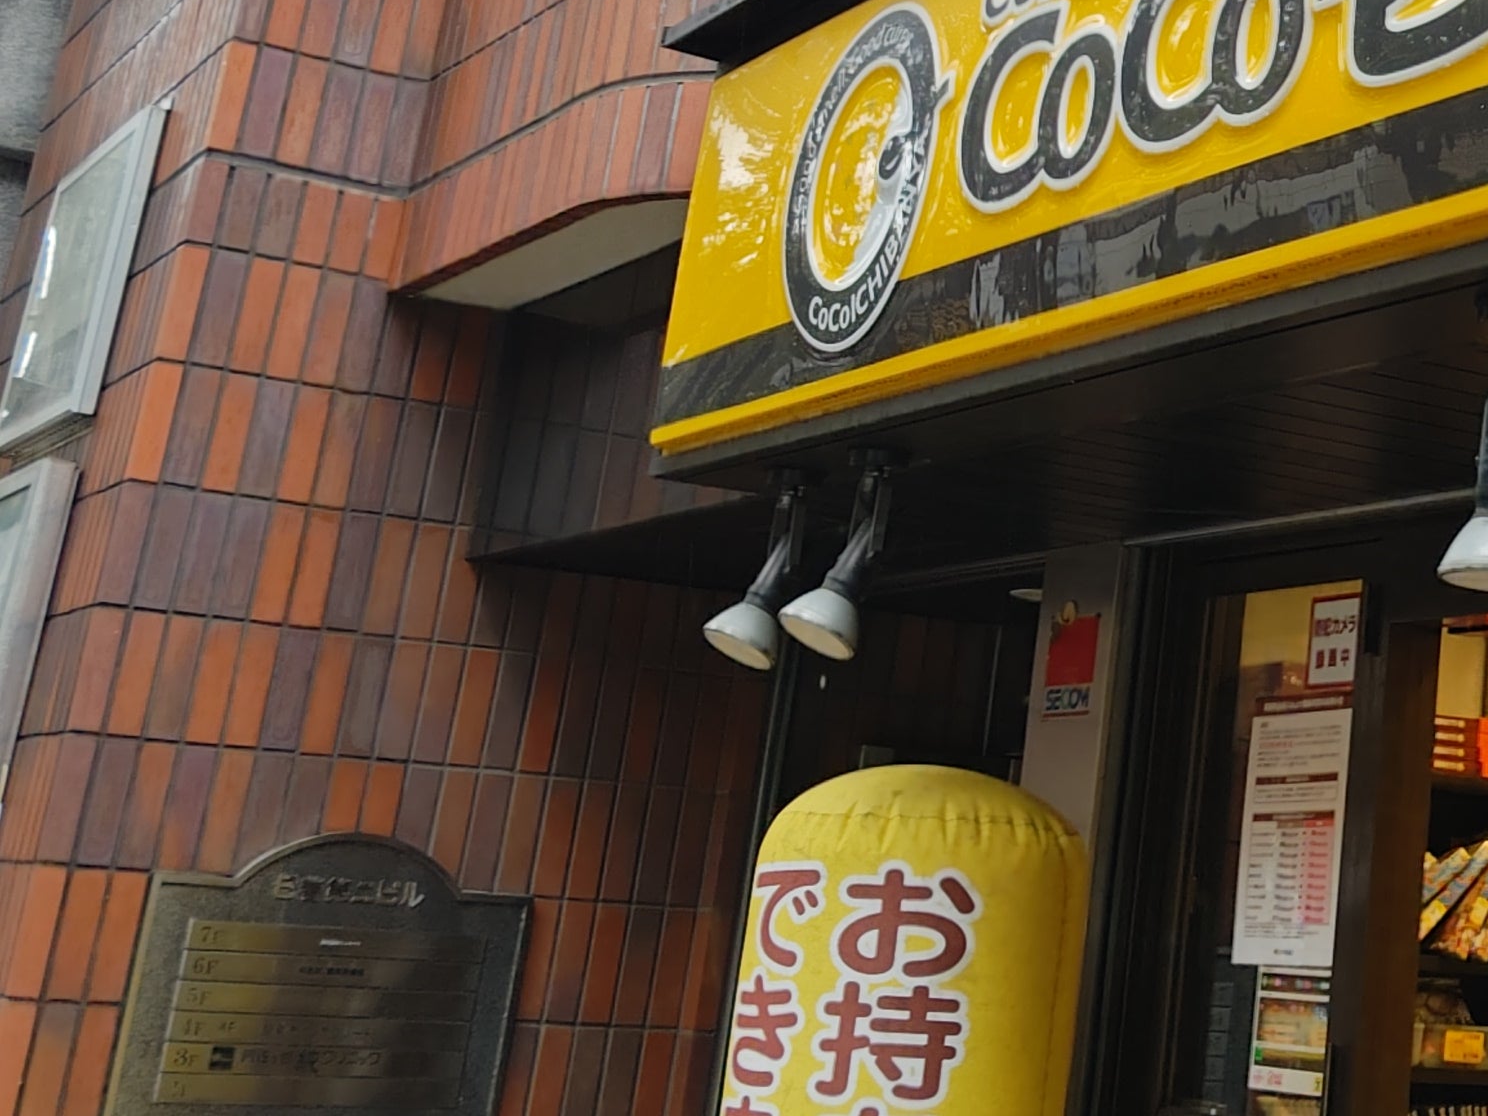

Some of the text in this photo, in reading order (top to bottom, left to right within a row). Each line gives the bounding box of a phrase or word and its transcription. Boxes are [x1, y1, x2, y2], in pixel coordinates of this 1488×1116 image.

[1045, 687, 1090, 711] SECOM
[192, 958, 219, 975] 6F
[725, 869, 821, 1116] でき
[815, 868, 976, 1116] お持
[173, 1049, 199, 1066] 3F
